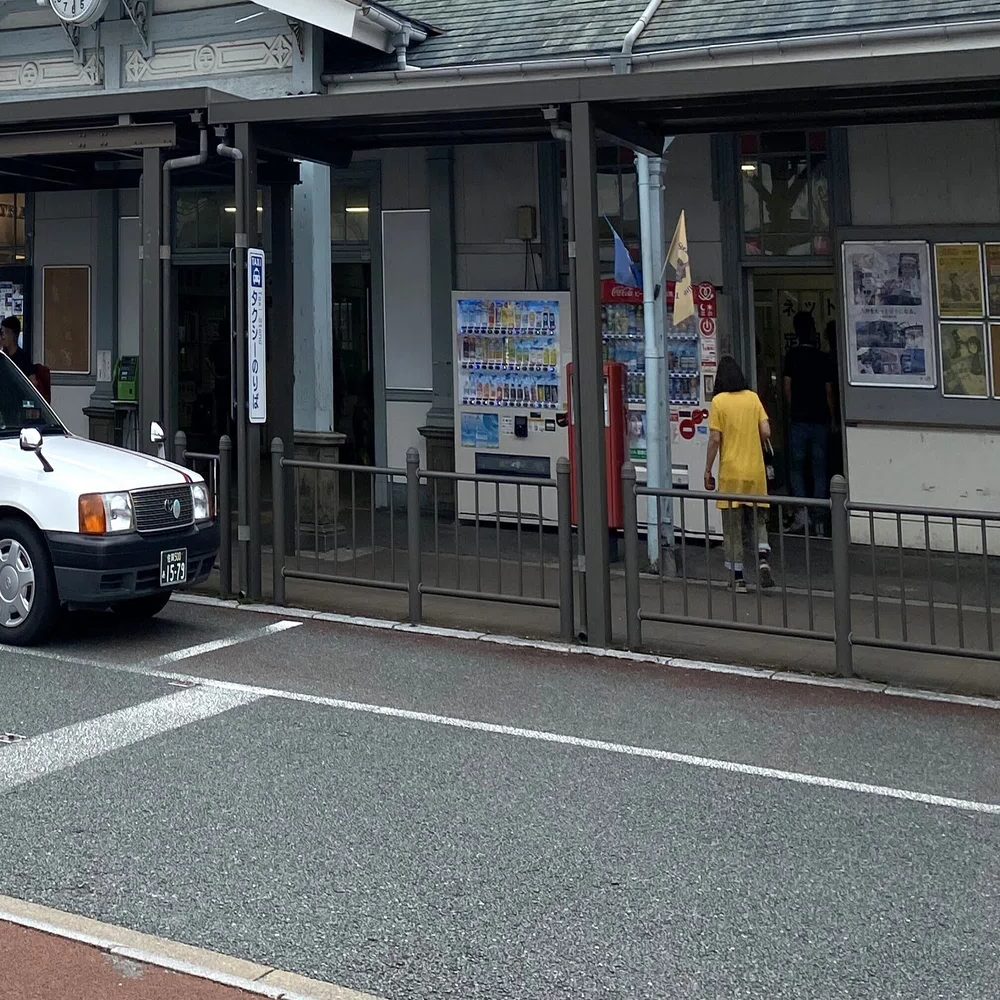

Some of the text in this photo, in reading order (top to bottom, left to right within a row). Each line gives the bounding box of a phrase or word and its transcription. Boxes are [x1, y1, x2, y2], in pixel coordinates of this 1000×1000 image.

[251, 290, 259, 410] タクシーのりば
